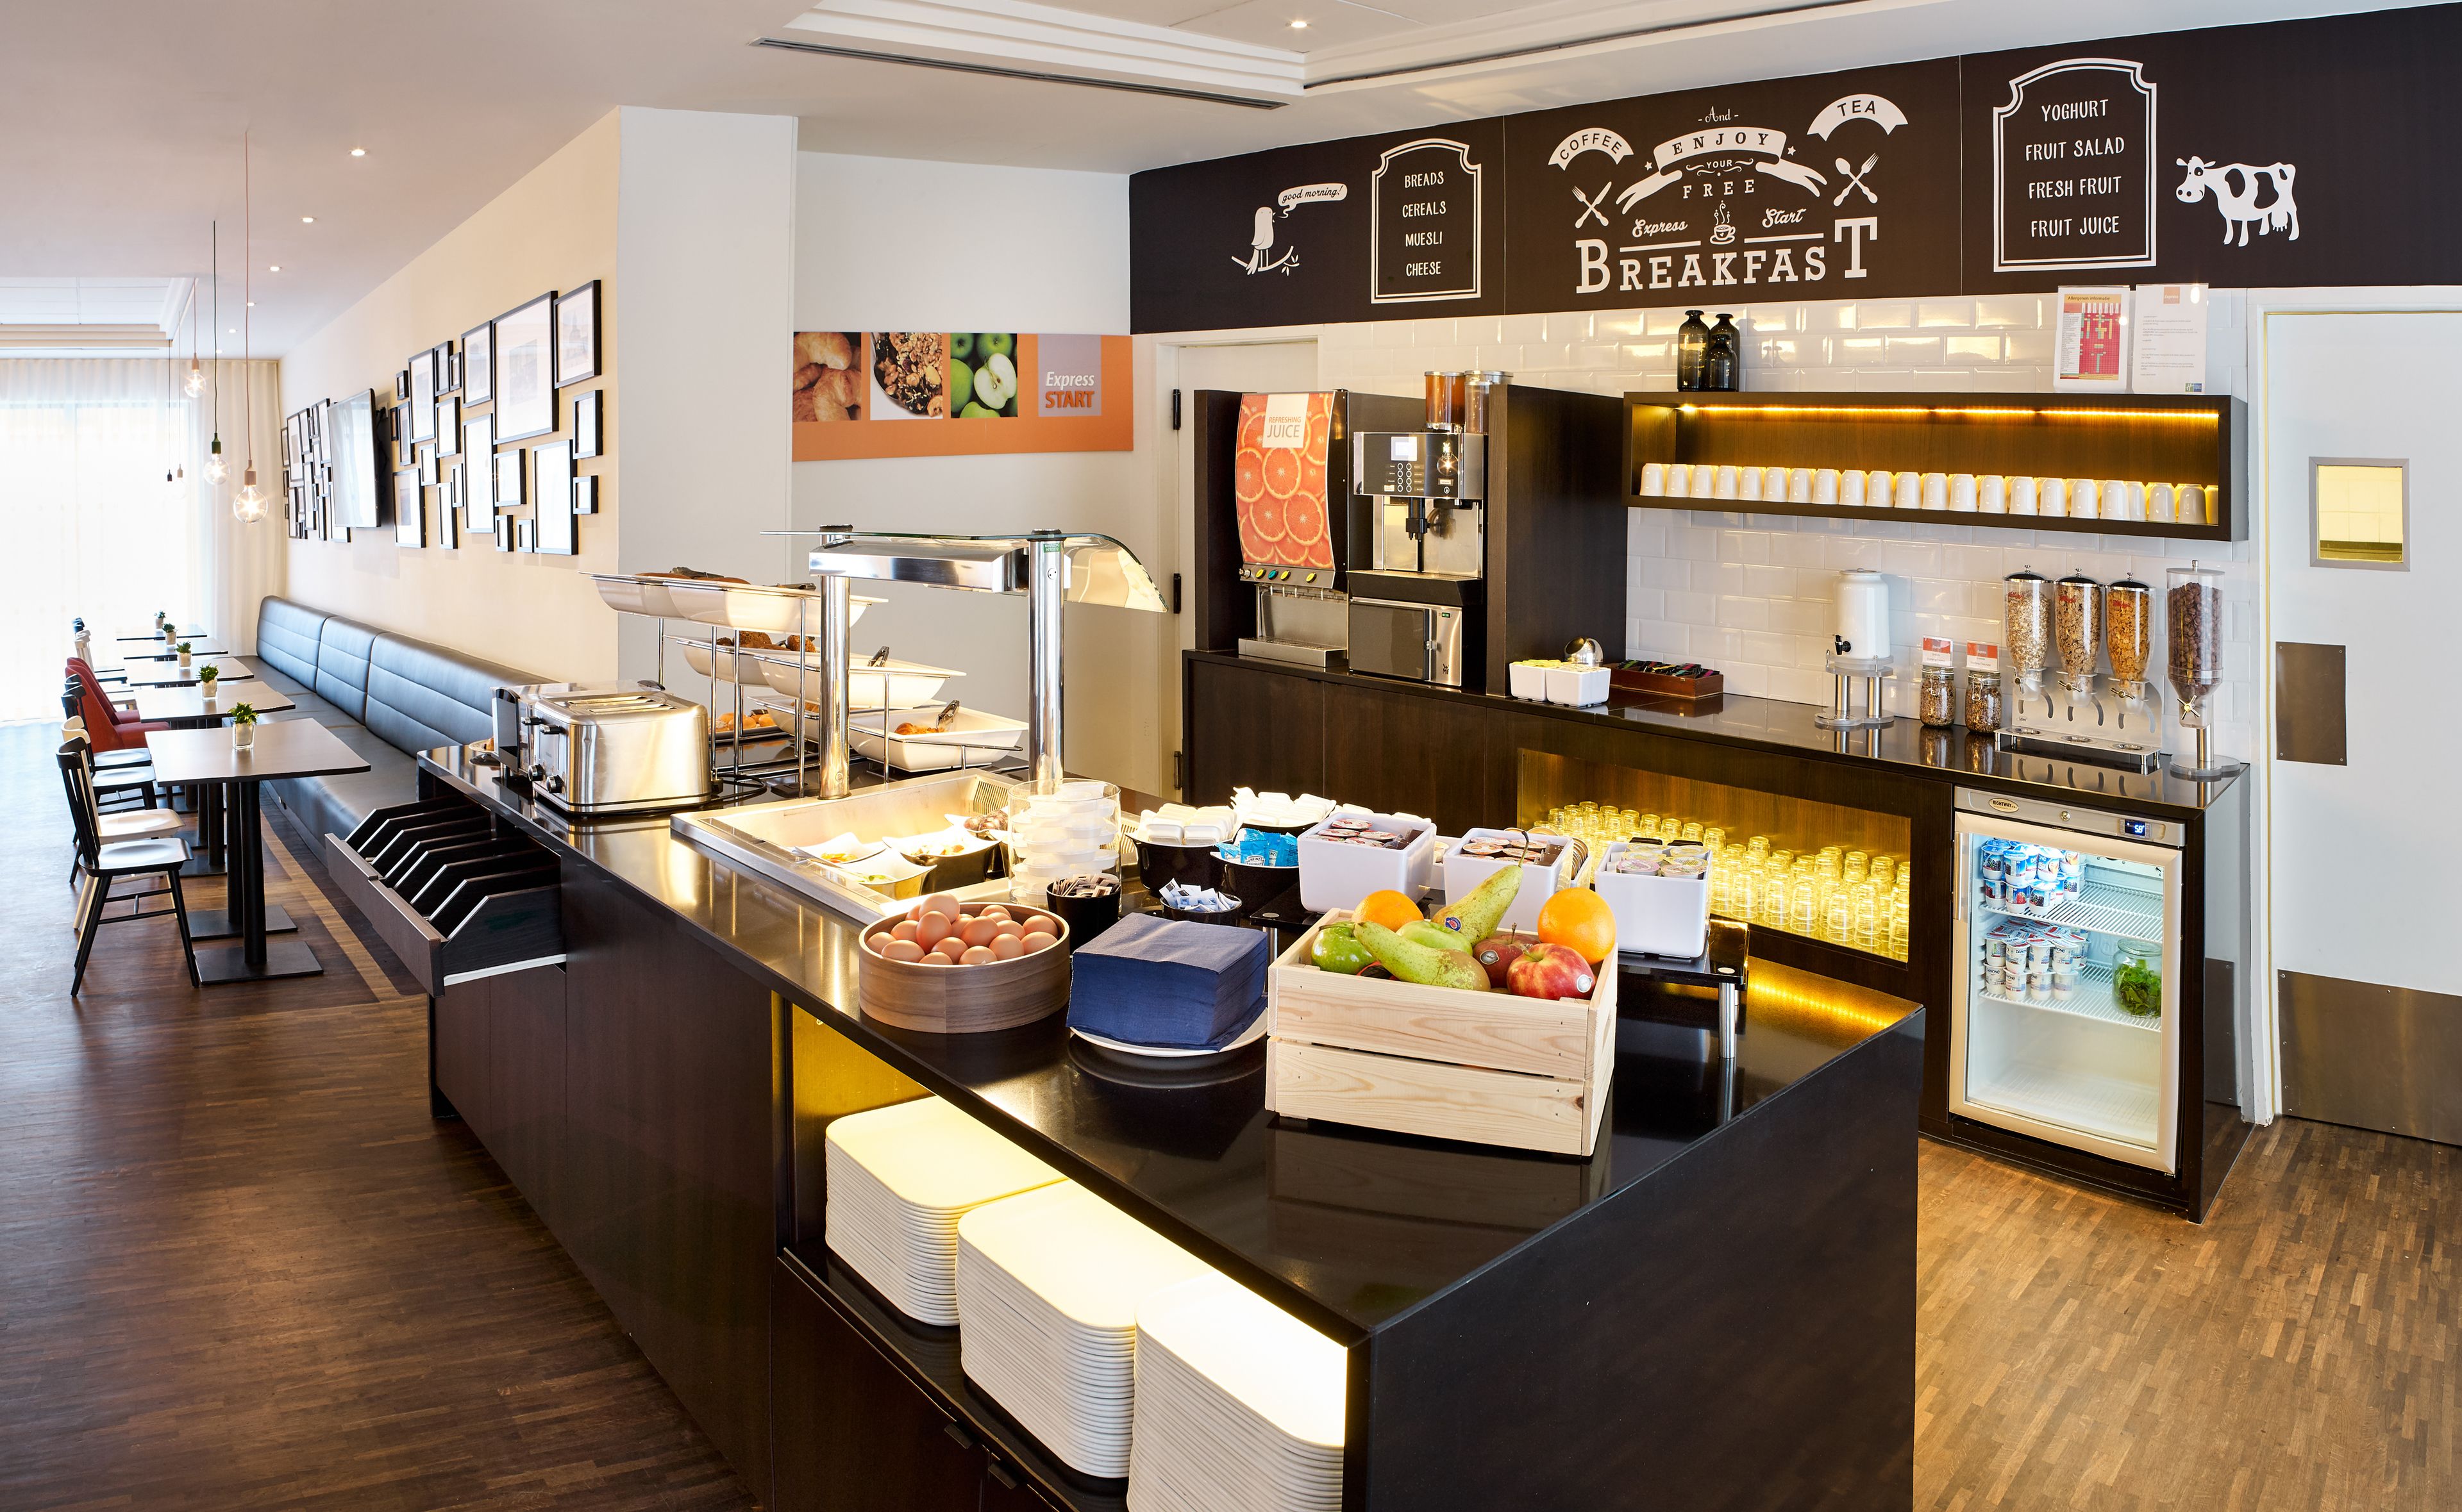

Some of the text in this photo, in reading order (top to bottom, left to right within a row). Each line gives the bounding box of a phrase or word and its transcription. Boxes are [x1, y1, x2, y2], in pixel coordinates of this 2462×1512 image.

[1705, 106, 1731, 122] And
[1838, 99, 1876, 117] TEA
[2041, 99, 2109, 122] YOGHURT
[1559, 133, 1622, 160] COFFEE
[1672, 132, 1770, 156] ENJOY
[2025, 137, 2125, 161] FRUIT SALAD
[1706, 160, 1732, 169] YOUR
[1405, 171, 1445, 188] BREADS
[1682, 179, 1755, 199] FREE
[2029, 176, 2122, 199] FRESH FRUIT
[1282, 185, 1343, 204] good morning!
[1402, 201, 1446, 218] CEREALS
[1762, 208, 1807, 228] Start
[1632, 219, 1688, 238] Express
[2031, 215, 2120, 238] FRUIT JUICE
[1405, 231, 1443, 247] MUESLI
[1575, 216, 1878, 294] BREAKFAST
[1406, 261, 1441, 277] CHEESE
[1046, 371, 1094, 390] Express
[1045, 391, 1094, 408] START
[1267, 424, 1300, 438] JUICE
